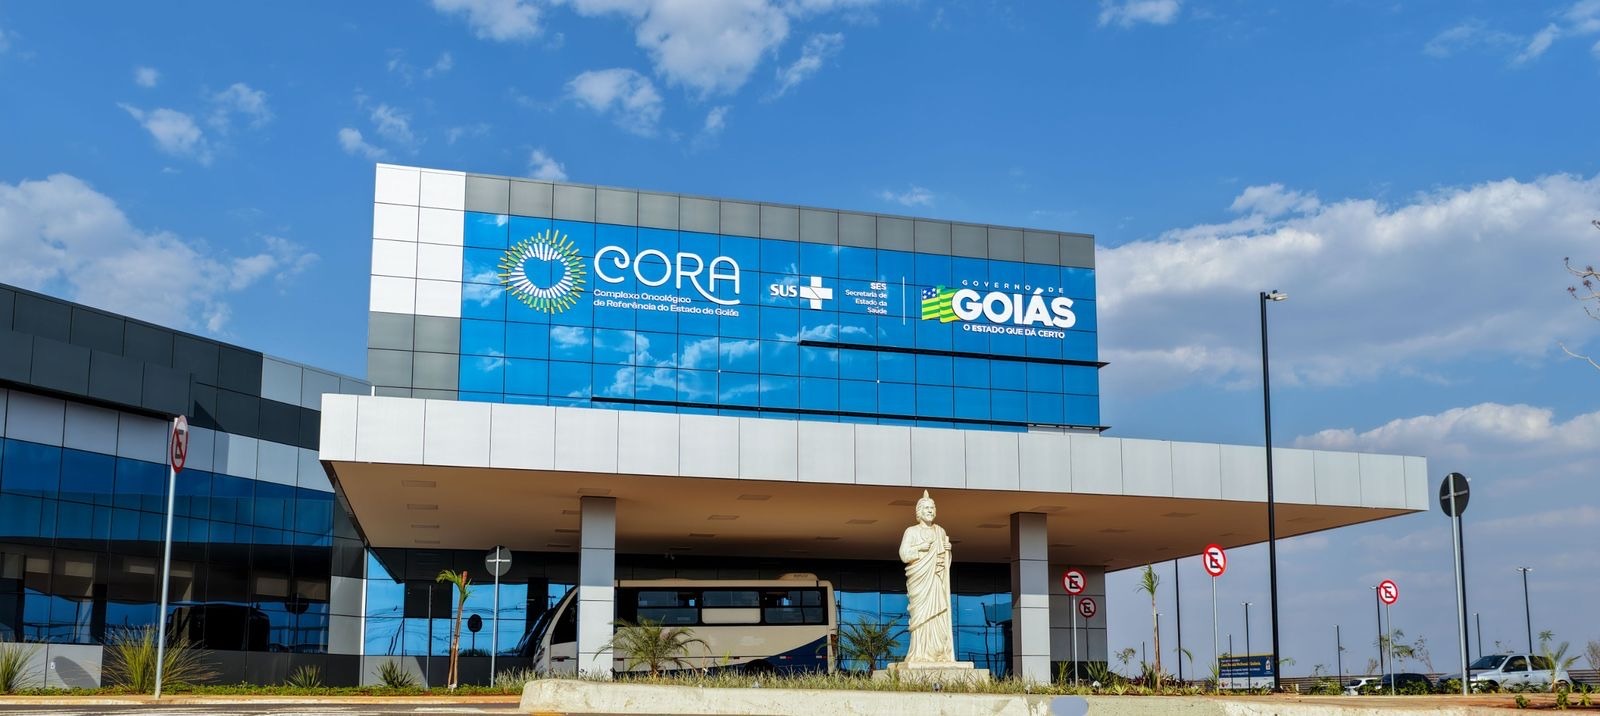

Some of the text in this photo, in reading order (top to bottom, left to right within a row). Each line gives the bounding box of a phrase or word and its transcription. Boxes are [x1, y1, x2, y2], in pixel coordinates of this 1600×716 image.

[593, 245, 741, 306] CORA
[770, 283, 798, 298] SUS
[845, 289, 888, 299] Secretaria de
[870, 282, 887, 291] SES
[962, 279, 1064, 294] GOVERNO DE
[593, 288, 692, 304] Complexo Oncológico
[855, 298, 888, 308] Estado da
[606, 299, 657, 311] Referência
[657, 303, 669, 312] do
[670, 304, 702, 315] Estado
[702, 307, 714, 316] de
[714, 308, 740, 318] Goiás
[867, 306, 888, 315] Saúde
[951, 287, 1076, 329] GOIÁS
[963, 323, 1066, 340] O ESTADO QUE DÁ CERTO
[1210, 552, 1219, 569] E
[1069, 575, 1079, 590] E
[1384, 586, 1392, 599] E
